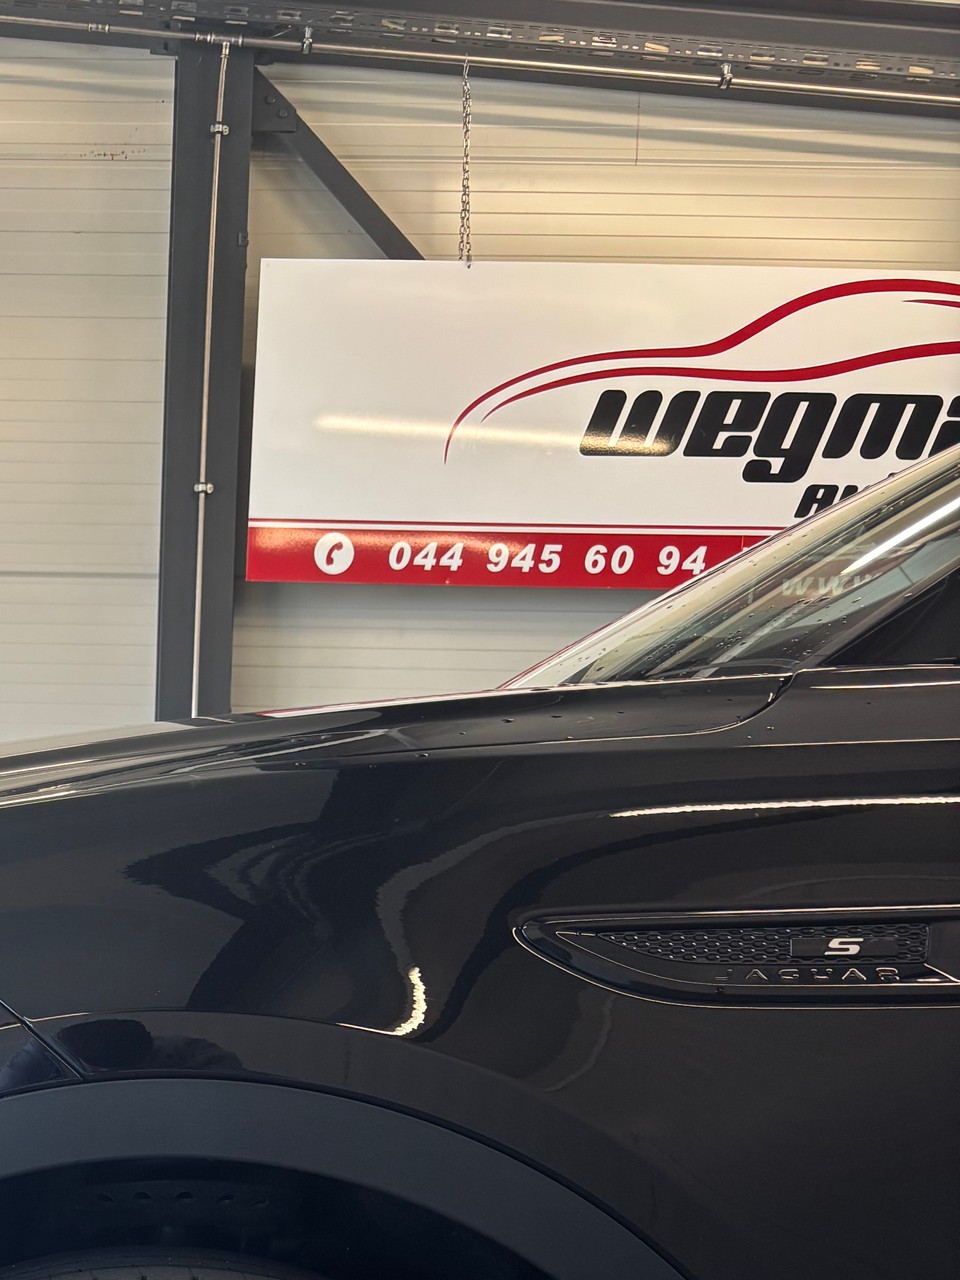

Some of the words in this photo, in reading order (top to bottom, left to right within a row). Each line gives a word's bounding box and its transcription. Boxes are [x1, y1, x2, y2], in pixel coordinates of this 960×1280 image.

[388, 542, 463, 573] 044
[486, 543, 562, 575] 945
[584, 546, 634, 575] 60
[657, 547, 707, 576] 94
[824, 937, 865, 956] S
[714, 967, 900, 981] JAGUAR
